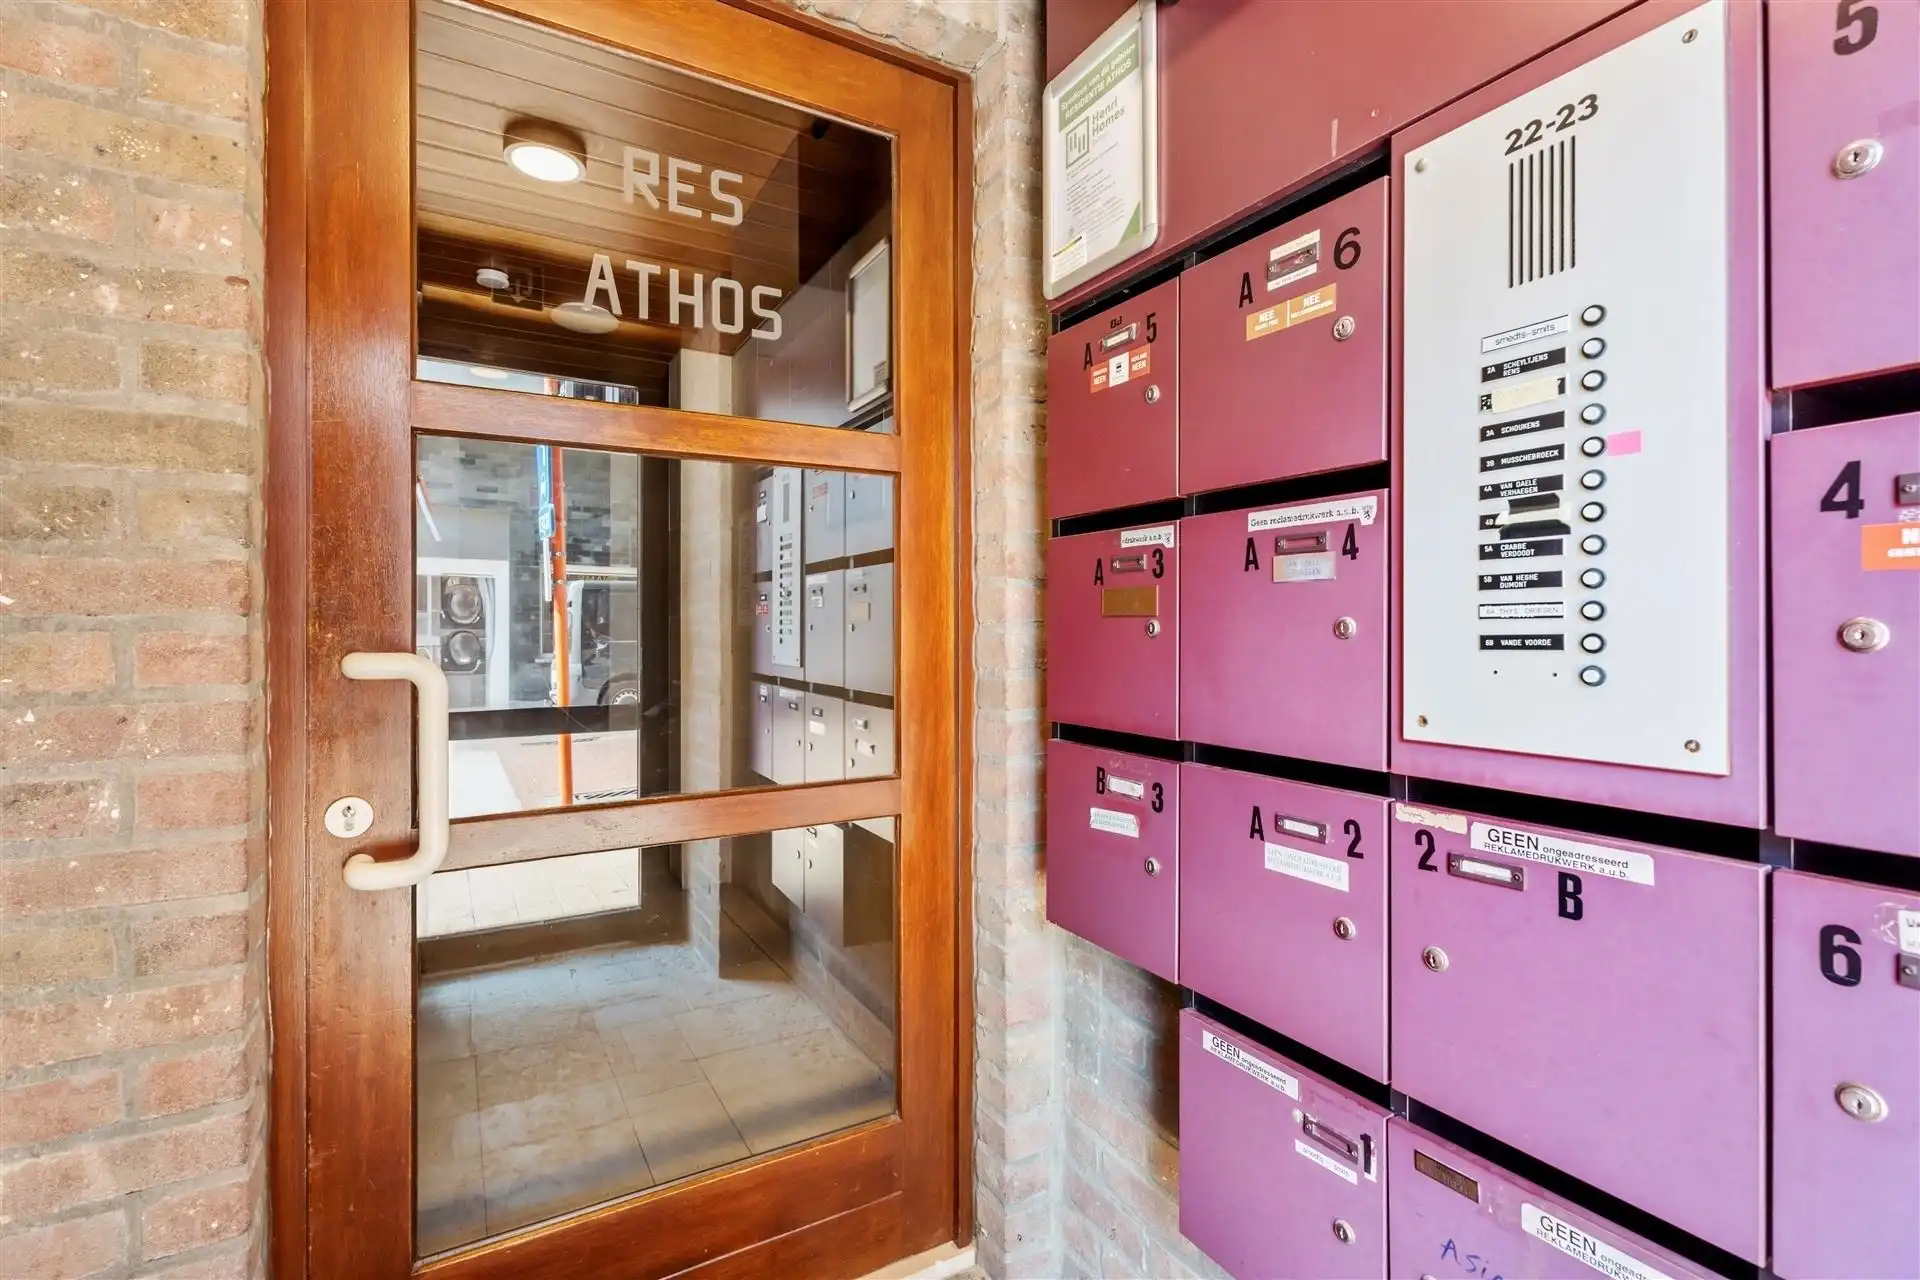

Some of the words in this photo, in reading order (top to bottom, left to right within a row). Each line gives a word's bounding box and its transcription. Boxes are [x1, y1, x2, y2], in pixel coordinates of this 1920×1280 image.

[1833, 0, 1879, 56] 5
[1092, 96, 1118, 125] Henri
[1092, 106, 1126, 137] Homes
[1504, 93, 1600, 156] 22-23
[621, 146, 744, 227] RES
[1333, 226, 1362, 271] 6
[582, 253, 784, 341] ATHOS
[1238, 271, 1254, 309] A
[1146, 312, 1157, 344] 5
[1083, 342, 1094, 371] A
[1487, 366, 1496, 375] 2A
[1503, 367, 1521, 377] RENS
[1486, 429, 1495, 437] 3A
[1501, 420, 1541, 435] SCHOUKENS
[1486, 459, 1495, 467] 3B
[1501, 449, 1559, 465] MUSSCHEBROECK
[1500, 481, 1513, 490] VAN
[1516, 479, 1537, 488] DAELE
[1500, 486, 1539, 497] VERHAEGEN
[1820, 460, 1865, 519] 4
[1250, 518, 1268, 527] Geen
[1485, 518, 1494, 526] 4B
[1244, 537, 1260, 572] A
[1342, 523, 1360, 560] 4
[1501, 542, 1527, 551] CRABBE
[1501, 549, 1535, 558] VERDOODT
[1094, 558, 1104, 586] A
[1152, 547, 1164, 579] 3
[1483, 575, 1492, 583] 5B
[1500, 574, 1513, 582] VAN
[1500, 581, 1527, 589] DUMONT
[1485, 639, 1494, 647] 6B
[1501, 639, 1522, 647] VANDE
[1525, 638, 1552, 646] VOORDE
[1096, 765, 1106, 795] B
[1151, 782, 1164, 813] 3
[1249, 805, 1265, 842] A
[1343, 818, 1364, 859] 2
[1414, 829, 1438, 873] 2
[1484, 842, 1596, 872] REKLAMEDRUKWERK
[1487, 828, 1540, 851] GEEN
[1542, 846, 1629, 870] ongeadresseerd
[1557, 871, 1583, 921] B
[1819, 924, 1863, 988] 6
[1212, 1036, 1240, 1060] GEEN
[1359, 1133, 1372, 1175] 1
[1540, 1215, 1597, 1256] GEEN
